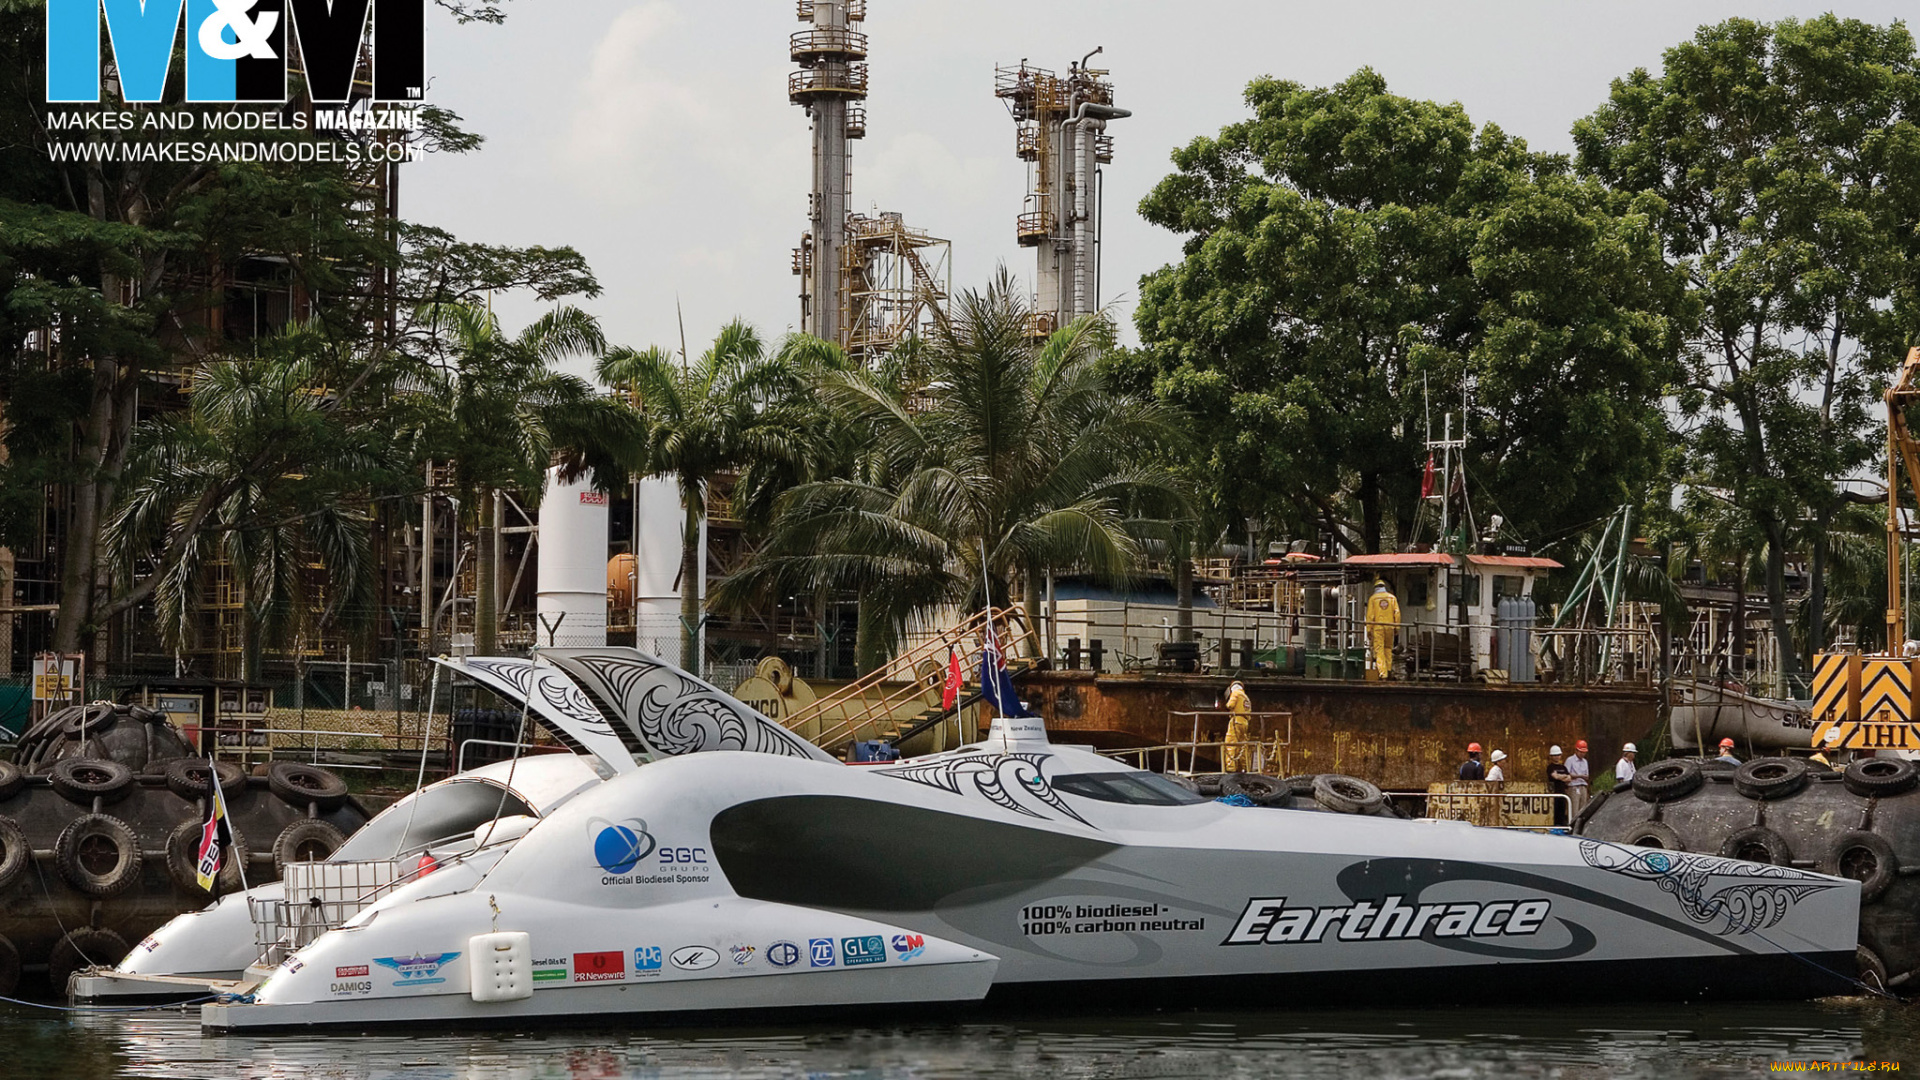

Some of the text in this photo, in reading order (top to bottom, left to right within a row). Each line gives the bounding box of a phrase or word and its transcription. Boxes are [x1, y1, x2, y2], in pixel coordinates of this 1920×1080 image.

[1862, 724, 1909, 748] IHI
[1501, 796, 1551, 815] SEMCO
[659, 847, 708, 864] SGC
[601, 874, 710, 886] Official Biodiesel Sponsor
[1022, 905, 1073, 920] 100%
[1075, 903, 1159, 918] biodiesel
[1220, 894, 1552, 946] Earthrace
[1022, 918, 1205, 935] 100% carbon neutral
[812, 944, 832, 961] ZF
[574, 972, 586, 981] PR
[586, 970, 625, 980] Newswire
[330, 981, 372, 993] DAMIOS
